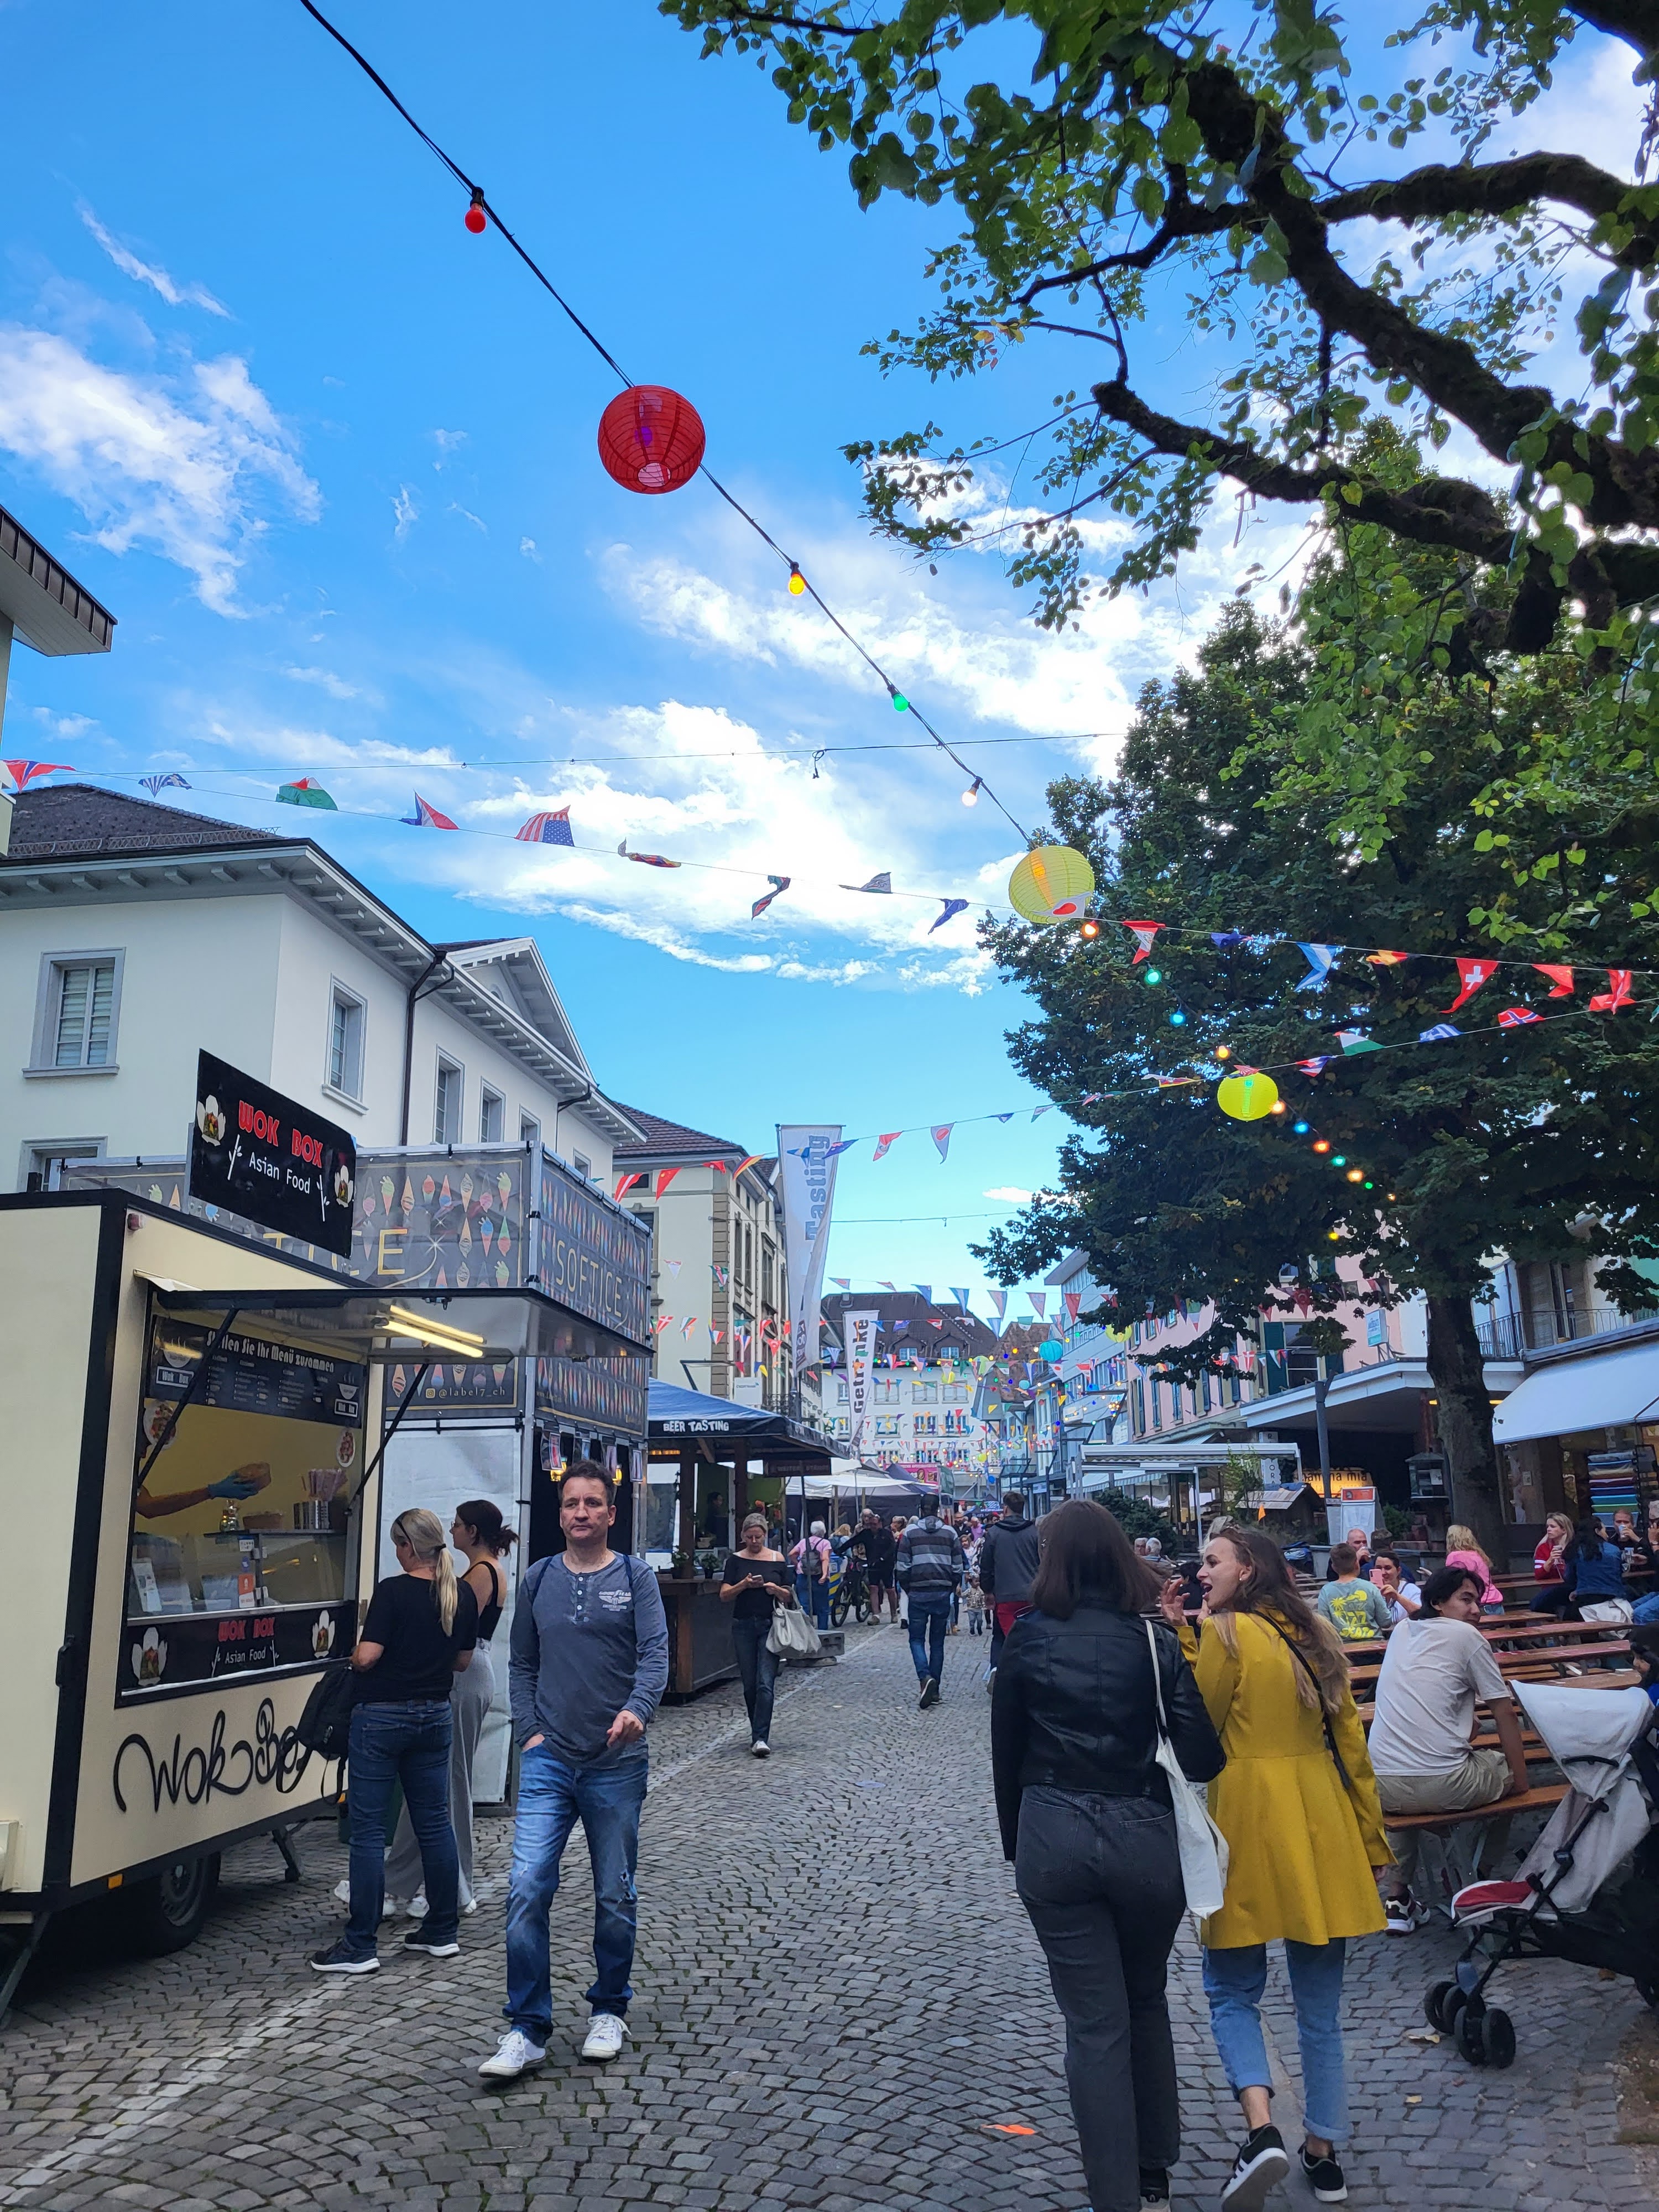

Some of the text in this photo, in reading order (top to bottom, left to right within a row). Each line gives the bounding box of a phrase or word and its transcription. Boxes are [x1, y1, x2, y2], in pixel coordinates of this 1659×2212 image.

[238, 1100, 324, 1168] WOK BOX
[249, 1152, 310, 1194] Asian Food
[804, 1135, 830, 1240] Tasting
[556, 1240, 622, 1318] SOFTICE
[207, 1330, 239, 1352] Sllen
[242, 1338, 255, 1355] Sie
[257, 1342, 270, 1359] Ihr
[271, 1345, 294, 1364] Menü
[295, 1354, 335, 1373] zusammen
[852, 1319, 869, 1413] Getrnke
[439, 1386, 505, 1399] @label7_ch
[663, 1419, 730, 1433] BEER TASTING
[1347, 1472, 1367, 1481] mia
[218, 1616, 275, 1642] WOK BOX
[225, 1646, 266, 1665] Asian Food
